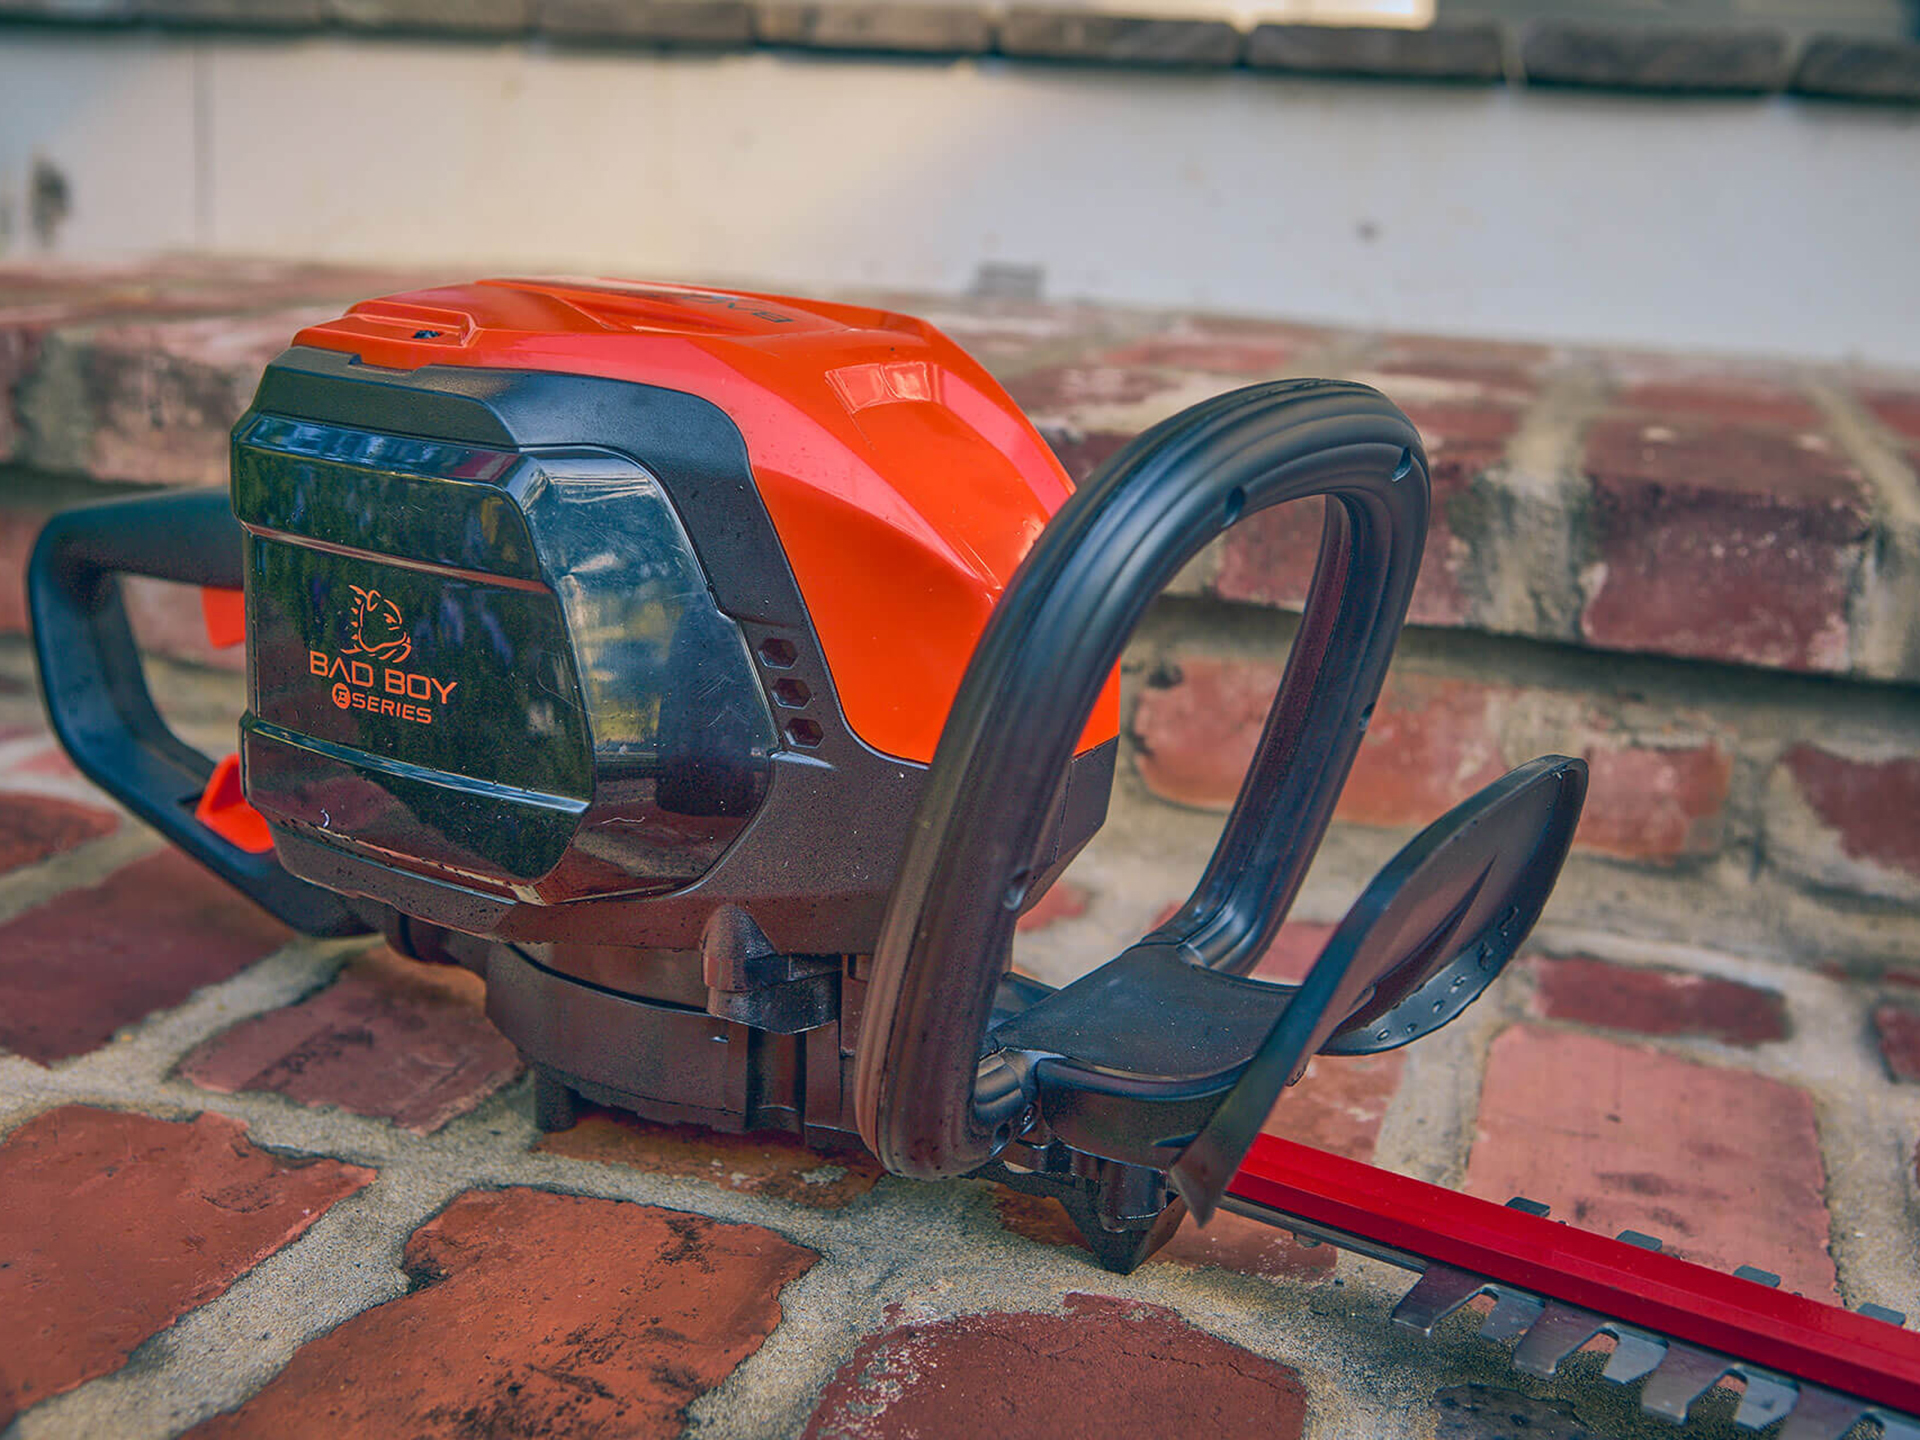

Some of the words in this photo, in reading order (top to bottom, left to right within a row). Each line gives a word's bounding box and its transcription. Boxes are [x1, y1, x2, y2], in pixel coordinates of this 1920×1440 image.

[310, 651, 374, 687] BAD
[385, 668, 458, 704] BOY
[352, 693, 432, 724] SERIES
